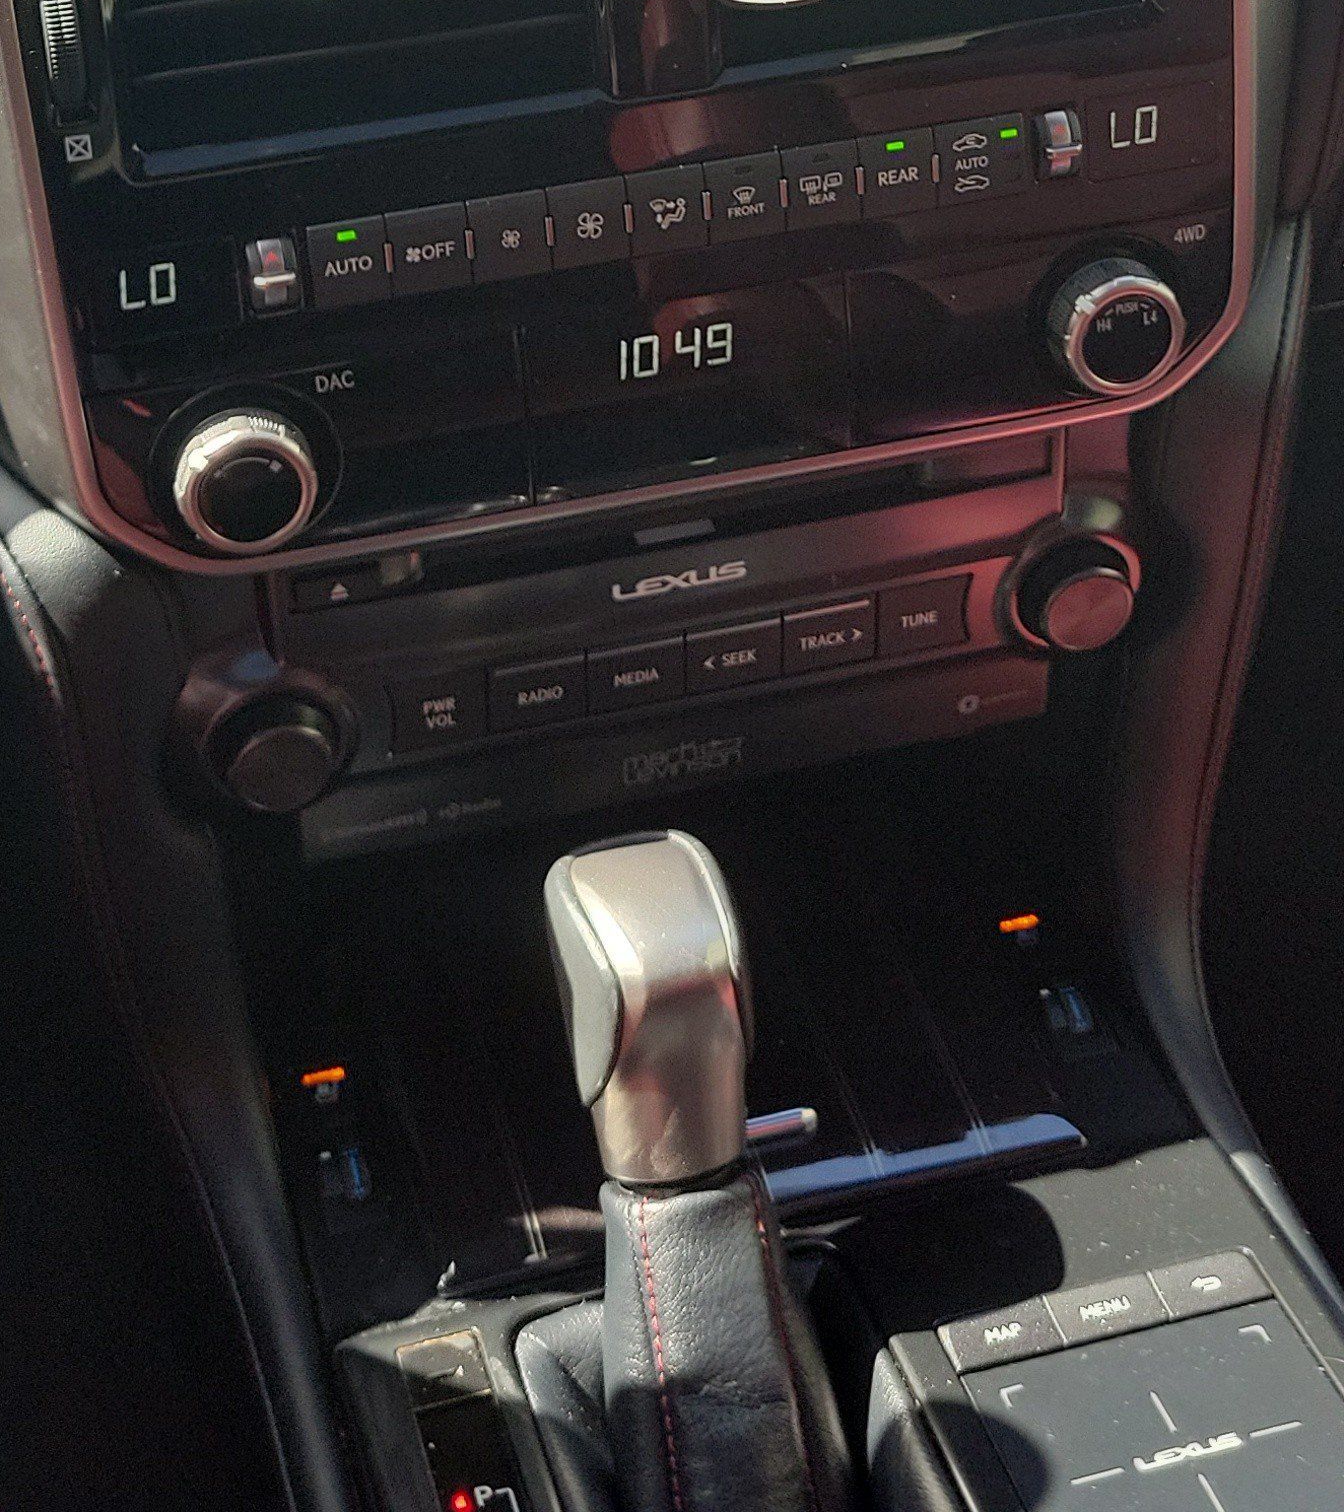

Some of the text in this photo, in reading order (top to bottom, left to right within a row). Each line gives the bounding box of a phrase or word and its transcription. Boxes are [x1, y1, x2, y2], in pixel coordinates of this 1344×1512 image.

[1109, 105, 1158, 149] LO
[954, 155, 989, 171] AUTO
[877, 165, 919, 187] REAR
[808, 190, 837, 205] REAR
[727, 201, 765, 219] FRONT
[1173, 224, 1206, 244] 4WD
[421, 240, 456, 261] OFF
[324, 255, 373, 278] AUTO
[119, 262, 177, 310] LO
[315, 369, 355, 392] DAC
[612, 560, 747, 601] LEXUS
[901, 609, 939, 629] TUNE
[800, 633, 846, 652] TRACK
[721, 648, 757, 668] SEEK
[613, 667, 659, 687] MEDIA
[423, 696, 456, 715] PWR
[517, 685, 564, 706] RADIO
[425, 713, 457, 729] VOL
[1079, 1295, 1131, 1321] MENU
[983, 1321, 1023, 1346] MAP
[1132, 1431, 1243, 1472] LEXUS
[473, 1484, 494, 1508] P
